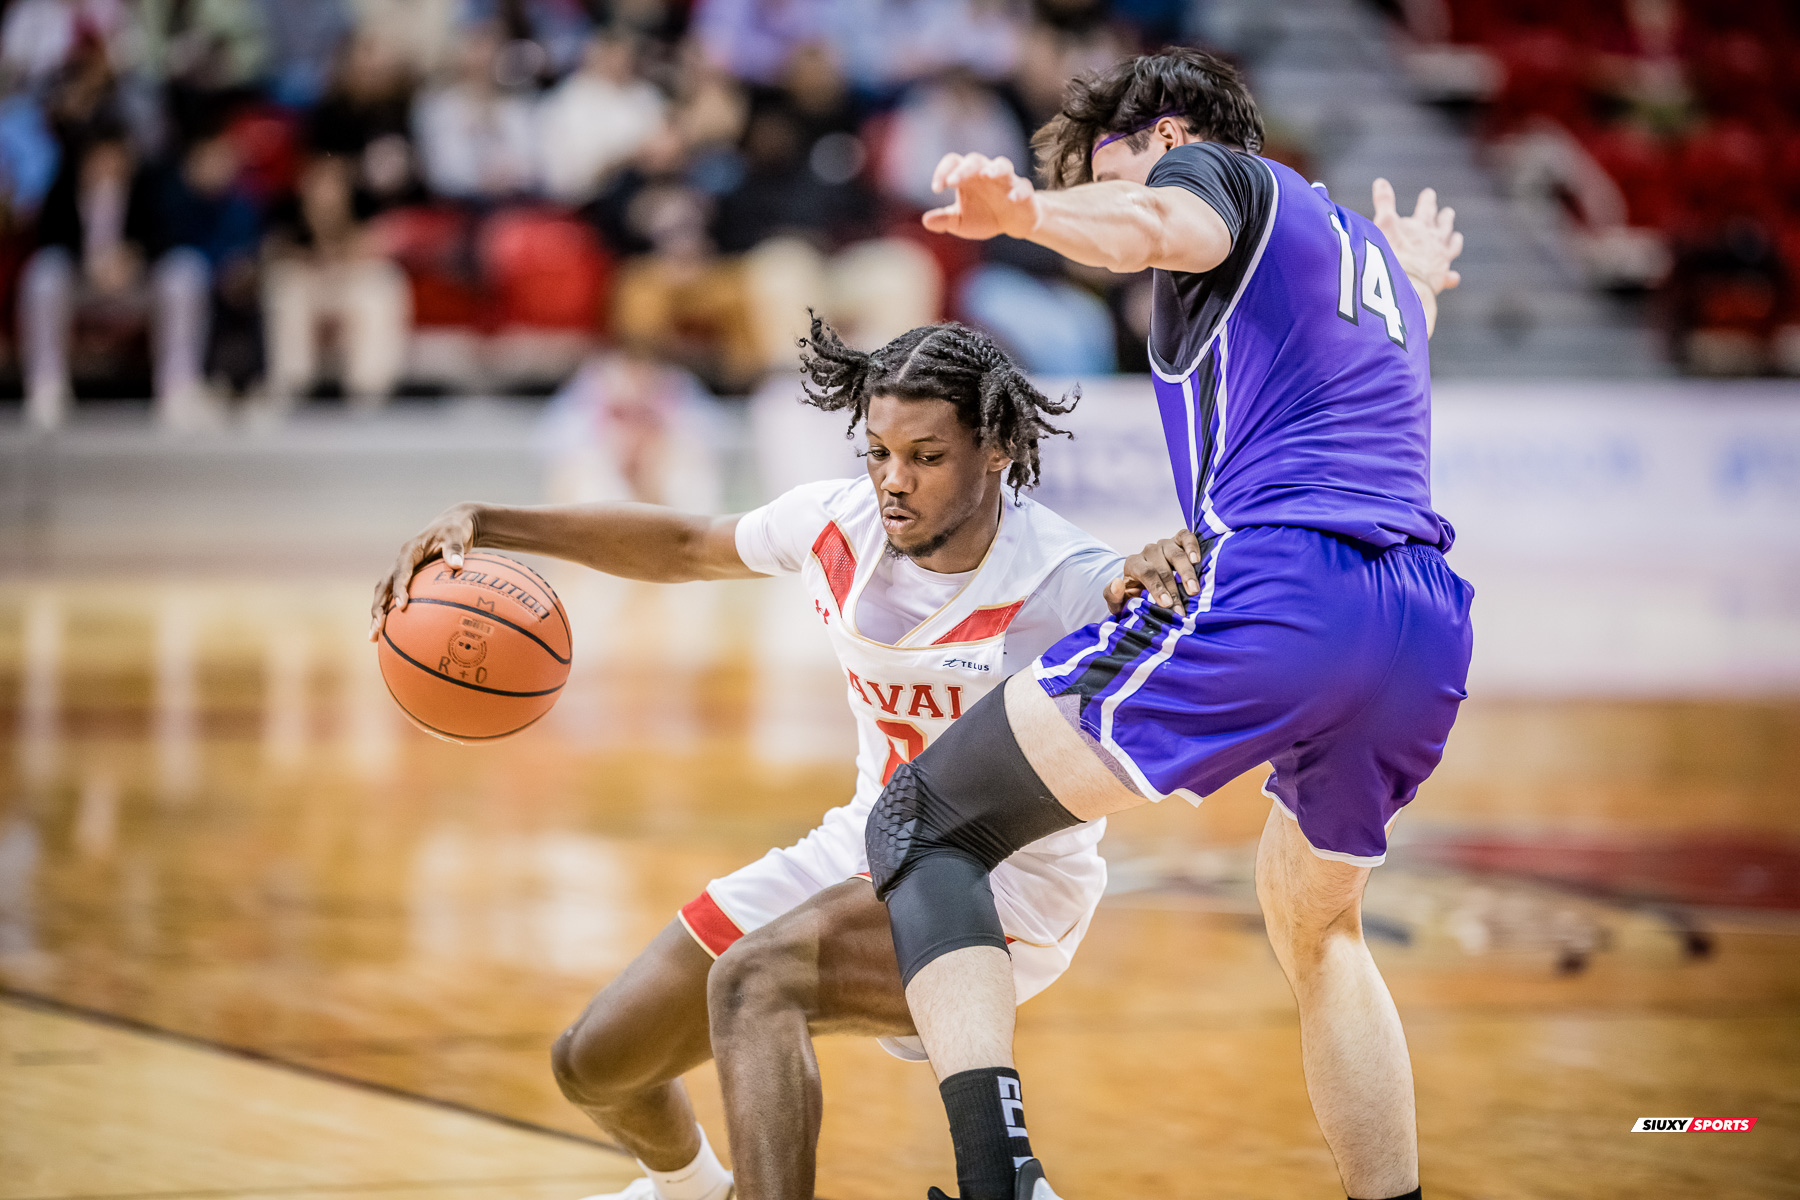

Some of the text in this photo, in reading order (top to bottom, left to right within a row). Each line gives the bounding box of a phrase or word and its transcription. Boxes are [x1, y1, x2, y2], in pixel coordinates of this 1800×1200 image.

[1328, 211, 1408, 353] 14
[476, 596, 495, 613] M
[438, 655, 451, 675] R
[961, 660, 990, 672] TELUS
